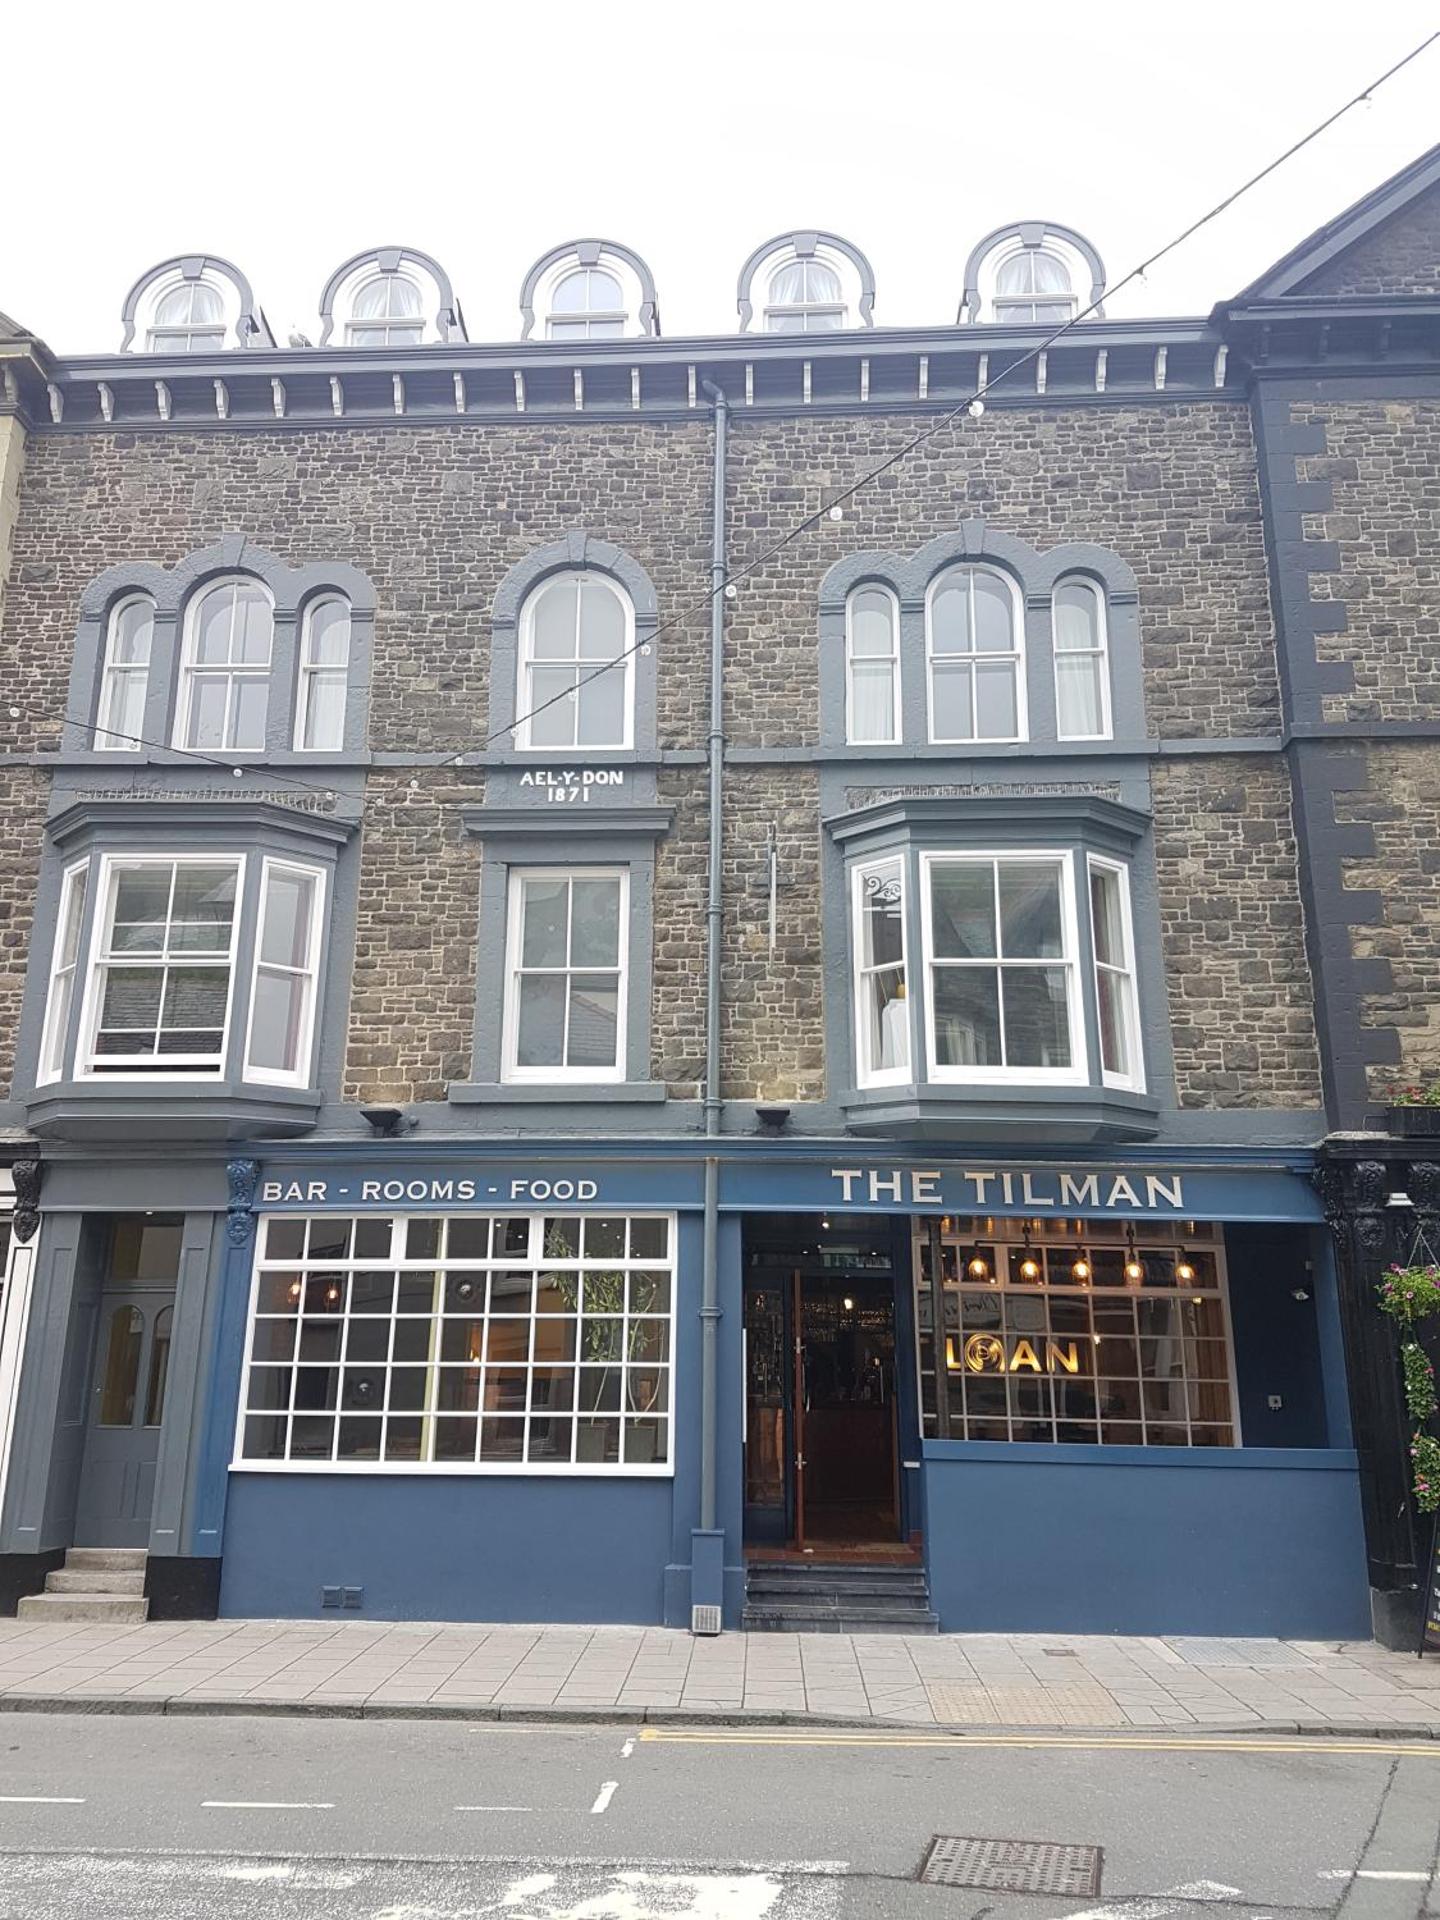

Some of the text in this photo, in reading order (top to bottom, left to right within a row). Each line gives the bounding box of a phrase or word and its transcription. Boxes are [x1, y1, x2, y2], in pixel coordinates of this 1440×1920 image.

[520, 771, 623, 786] AEL-Y-DON
[548, 787, 590, 802] 1871
[262, 1181, 327, 1202] BAR
[361, 1180, 476, 1202] ROOMS
[510, 1179, 598, 1201] FOOD
[831, 1169, 1184, 1207] THE TILMAN
